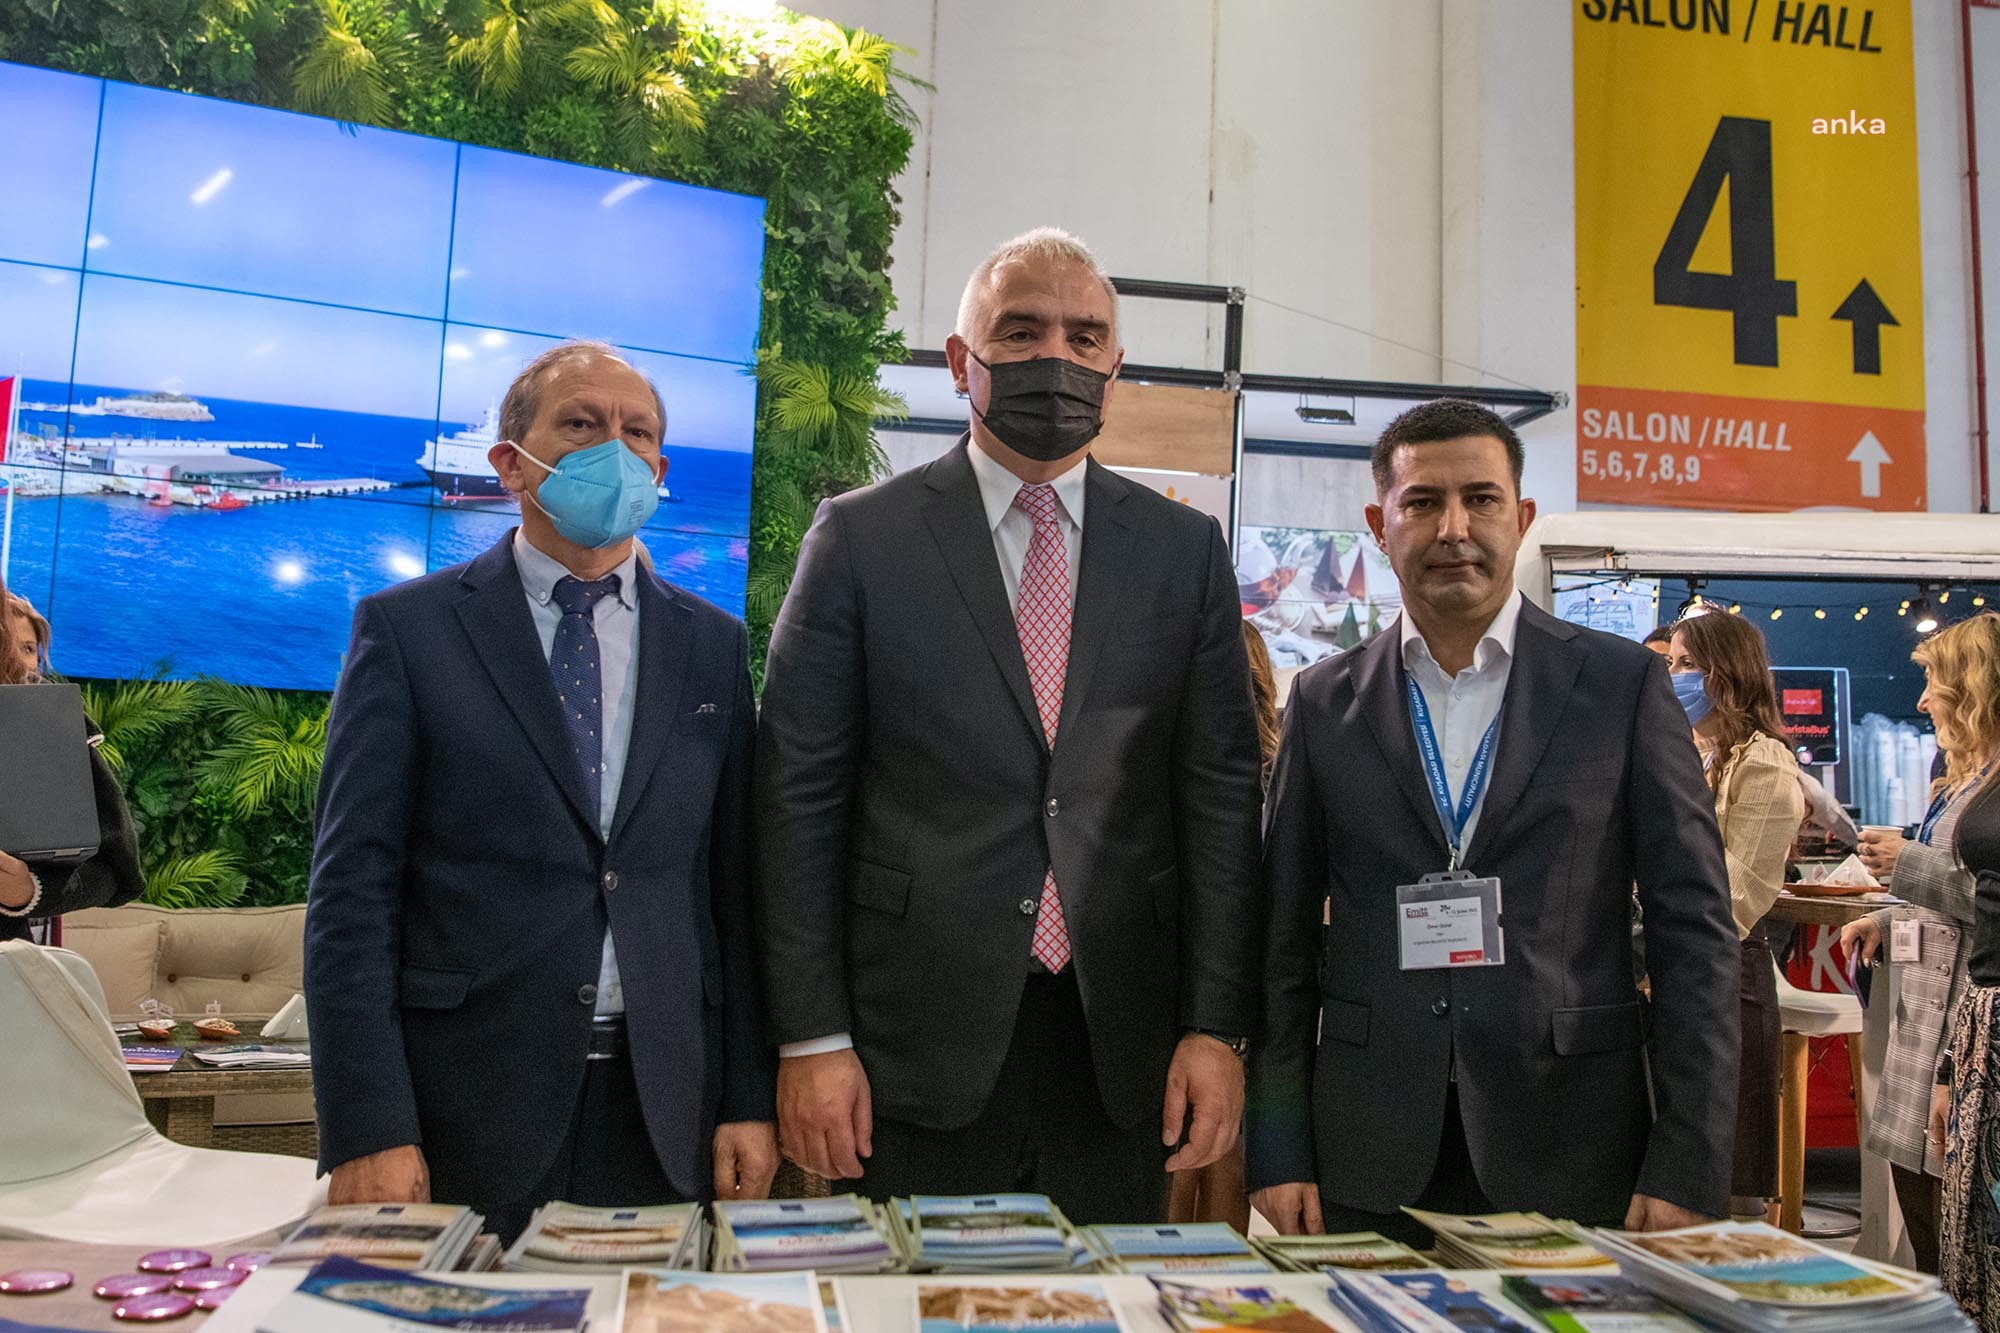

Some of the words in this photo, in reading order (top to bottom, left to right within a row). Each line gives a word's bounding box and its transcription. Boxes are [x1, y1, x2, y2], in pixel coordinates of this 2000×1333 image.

[1772, 0, 1882, 53] HALL
[1654, 115, 1798, 368] 4
[1582, 408, 1690, 444] SALON
[1582, 449, 1700, 485] 5,6,7,8,9
